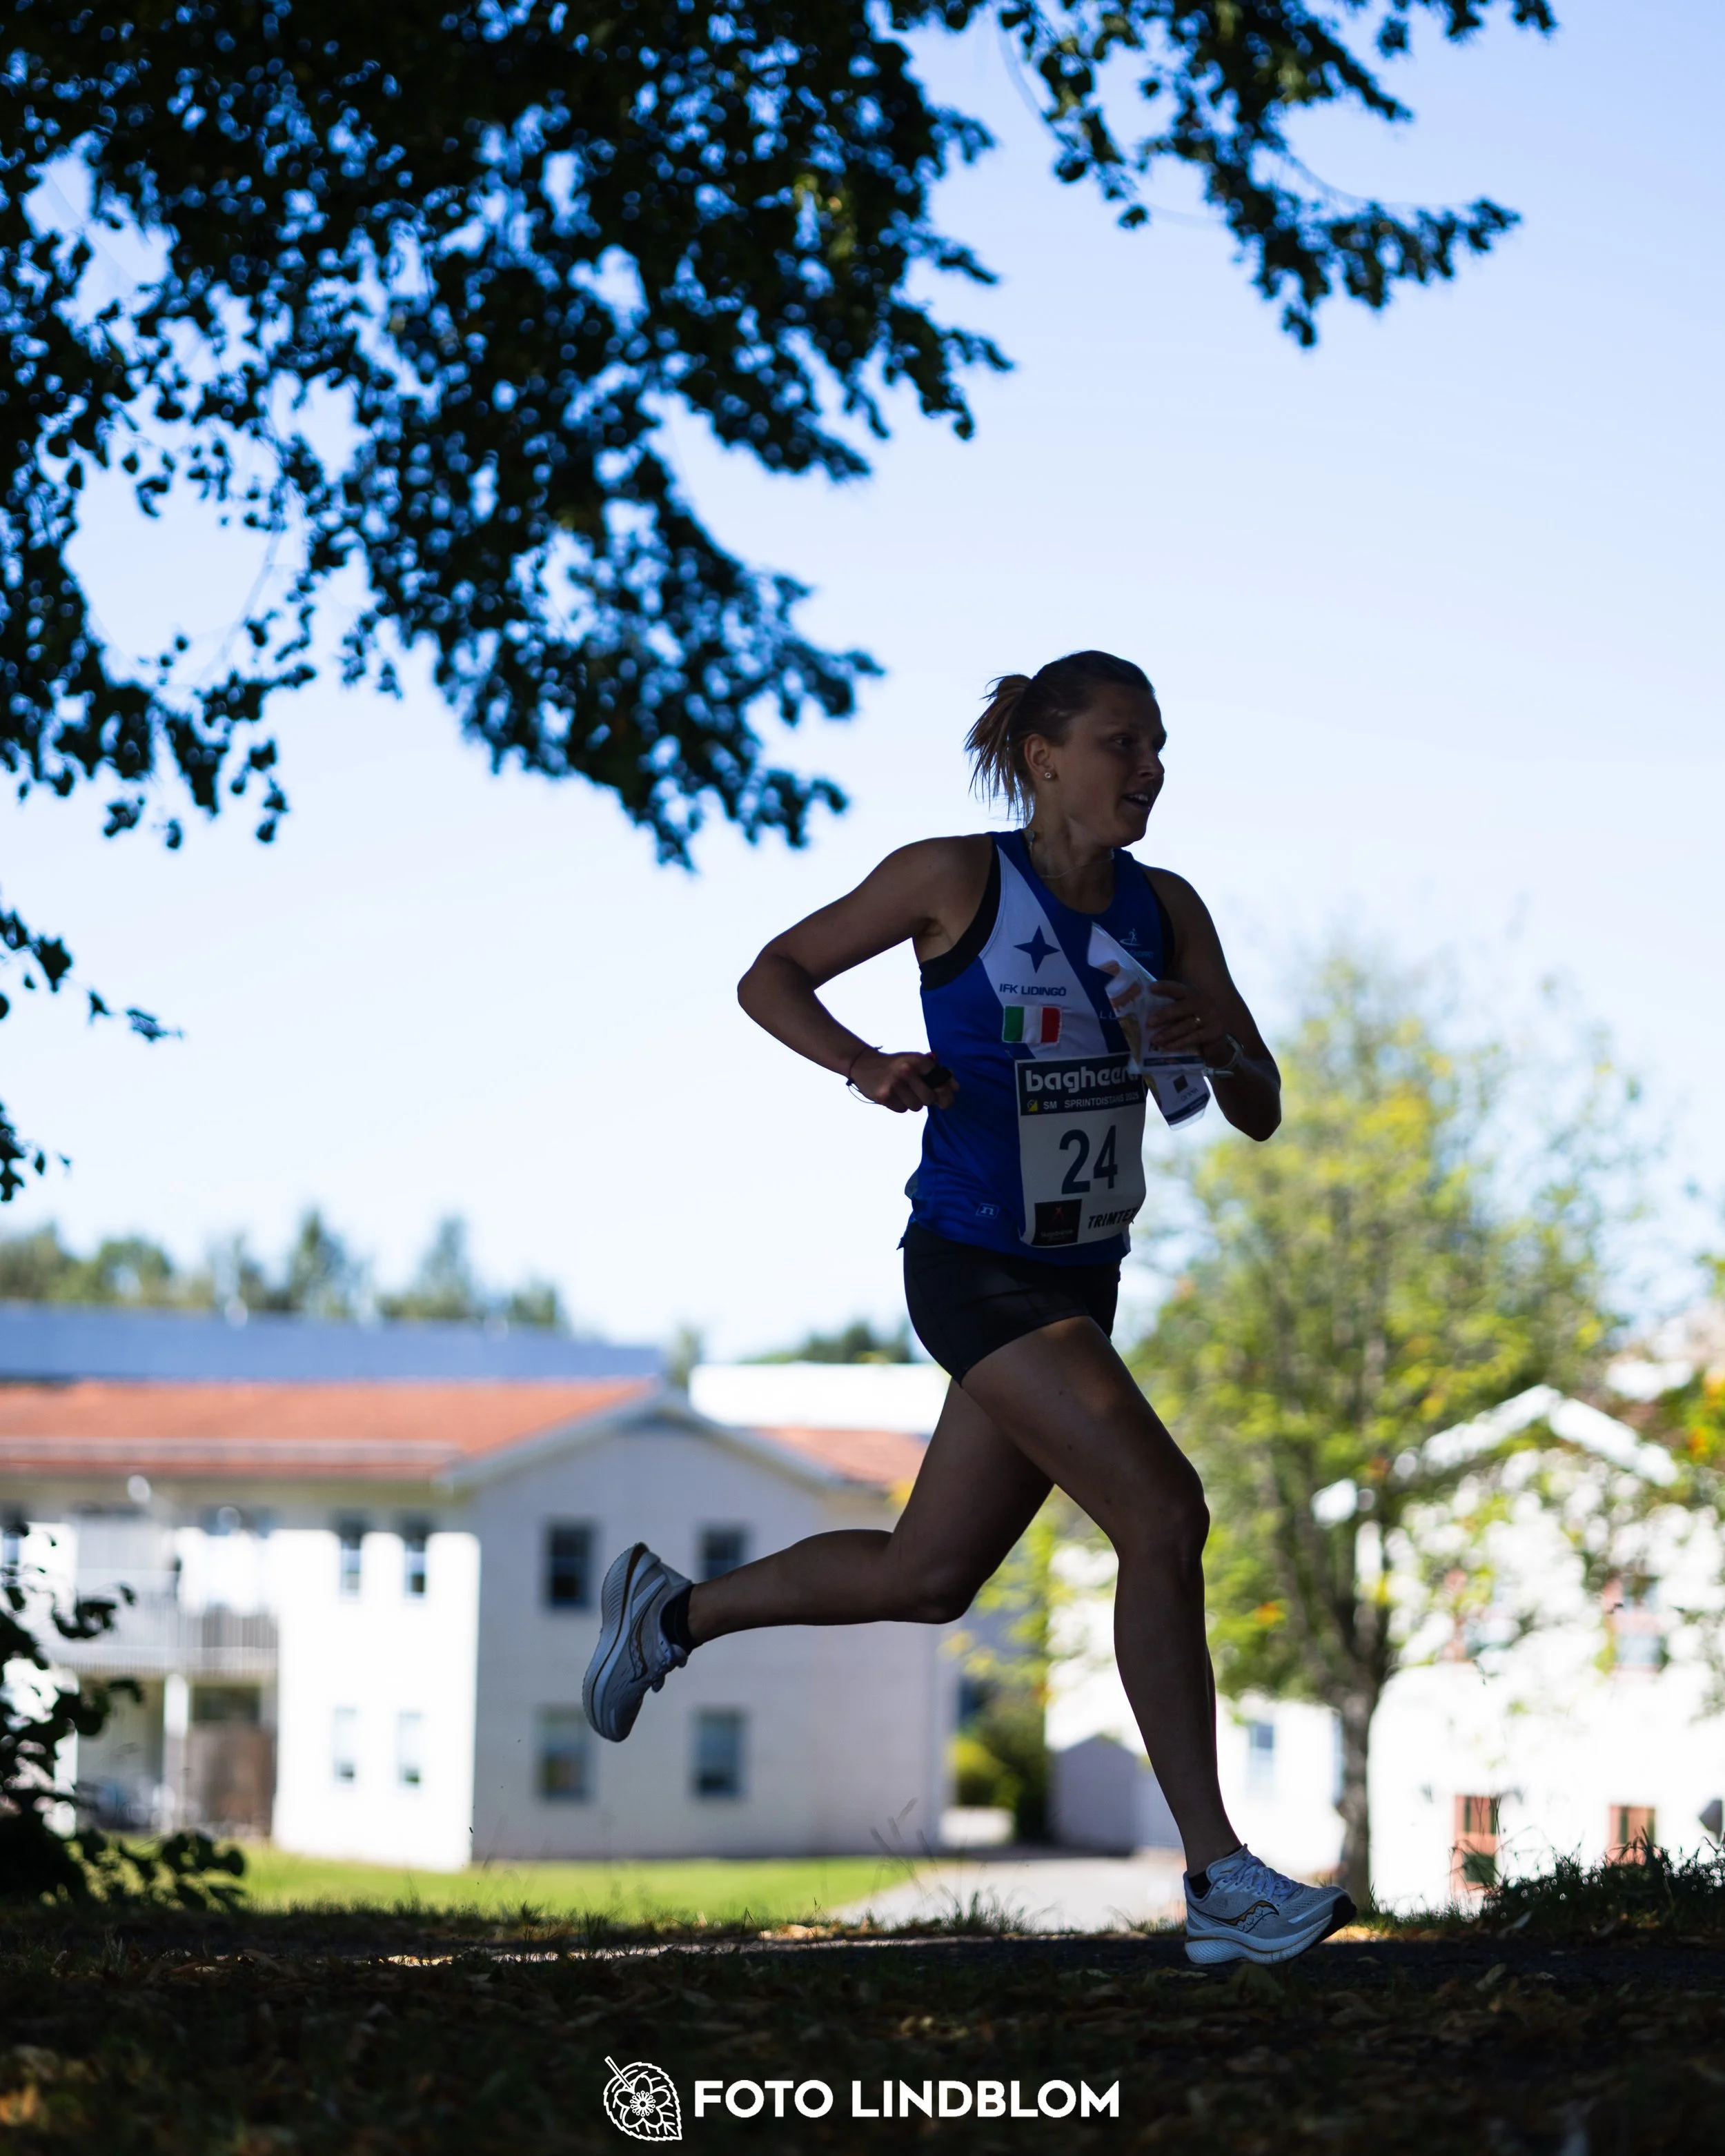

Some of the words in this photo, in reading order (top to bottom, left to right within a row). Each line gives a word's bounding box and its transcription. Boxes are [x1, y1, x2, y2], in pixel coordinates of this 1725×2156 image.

[1000, 984, 1018, 993] IFK
[1043, 1100, 1057, 1110] SM
[1064, 1094, 1124, 1109] SPRINTDISTANS
[1059, 1125, 1118, 1194] 24
